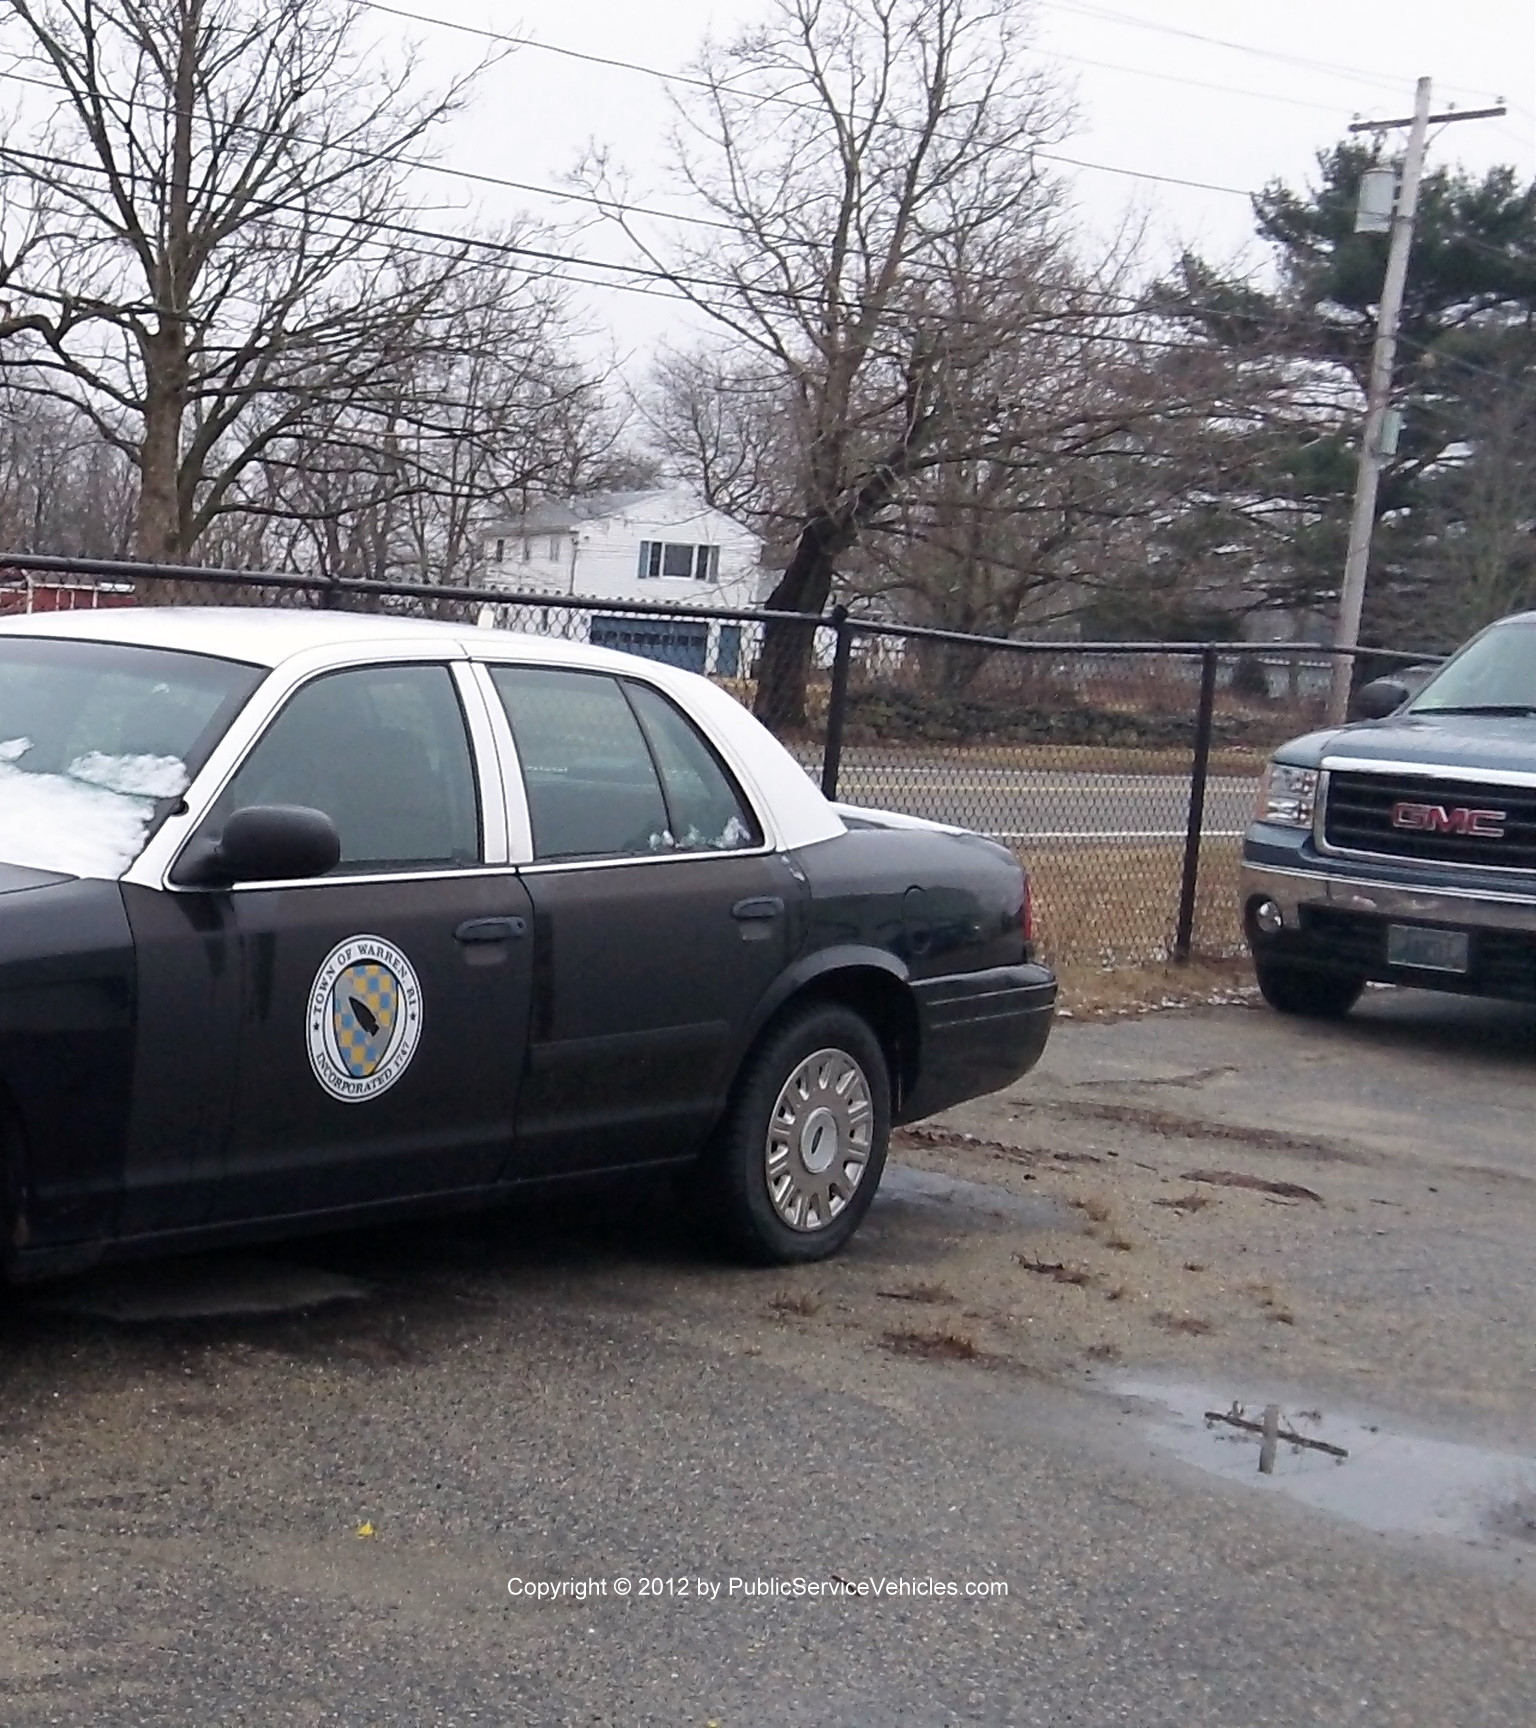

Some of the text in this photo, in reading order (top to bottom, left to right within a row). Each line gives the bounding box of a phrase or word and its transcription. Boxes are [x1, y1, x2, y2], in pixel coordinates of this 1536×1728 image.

[1391, 801, 1506, 838] GMC
[313, 966, 338, 1014] TOWN
[337, 949, 352, 966] OF
[406, 986, 416, 1005] RI
[316, 1041, 410, 1094] INCORPORATED 1747
